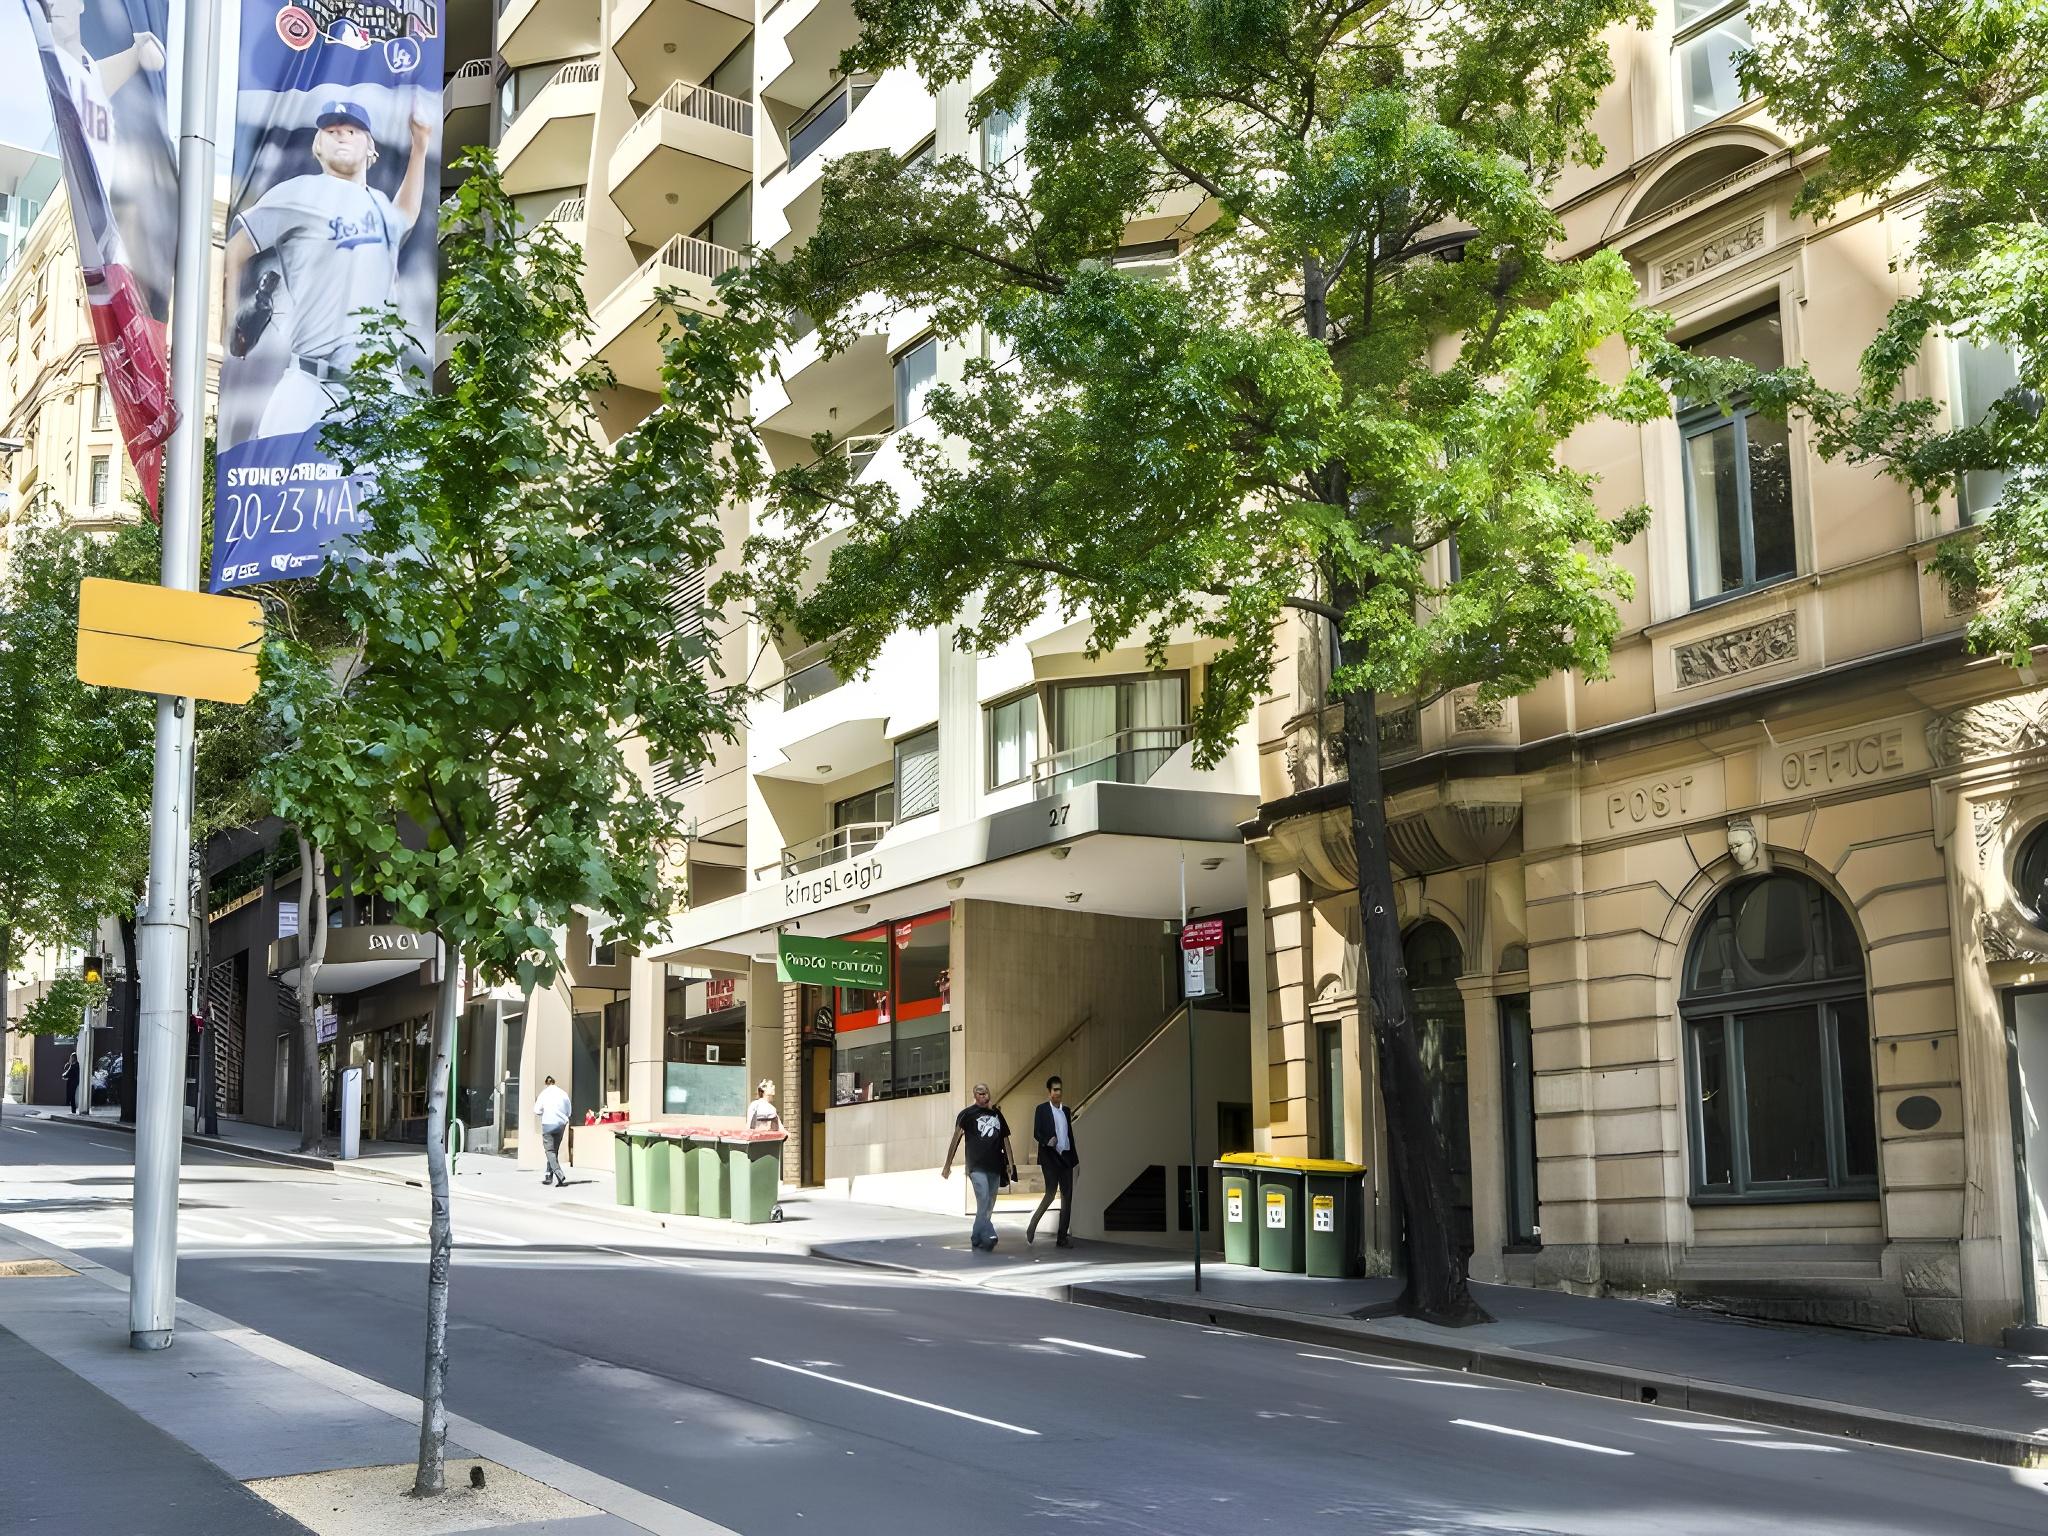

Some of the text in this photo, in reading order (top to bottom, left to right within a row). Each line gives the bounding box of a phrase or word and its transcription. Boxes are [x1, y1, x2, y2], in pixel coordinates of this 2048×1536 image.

[225, 487, 306, 543] 20-23
[1606, 727, 1905, 830] POST OFFICE
[1049, 803, 1071, 828] 27
